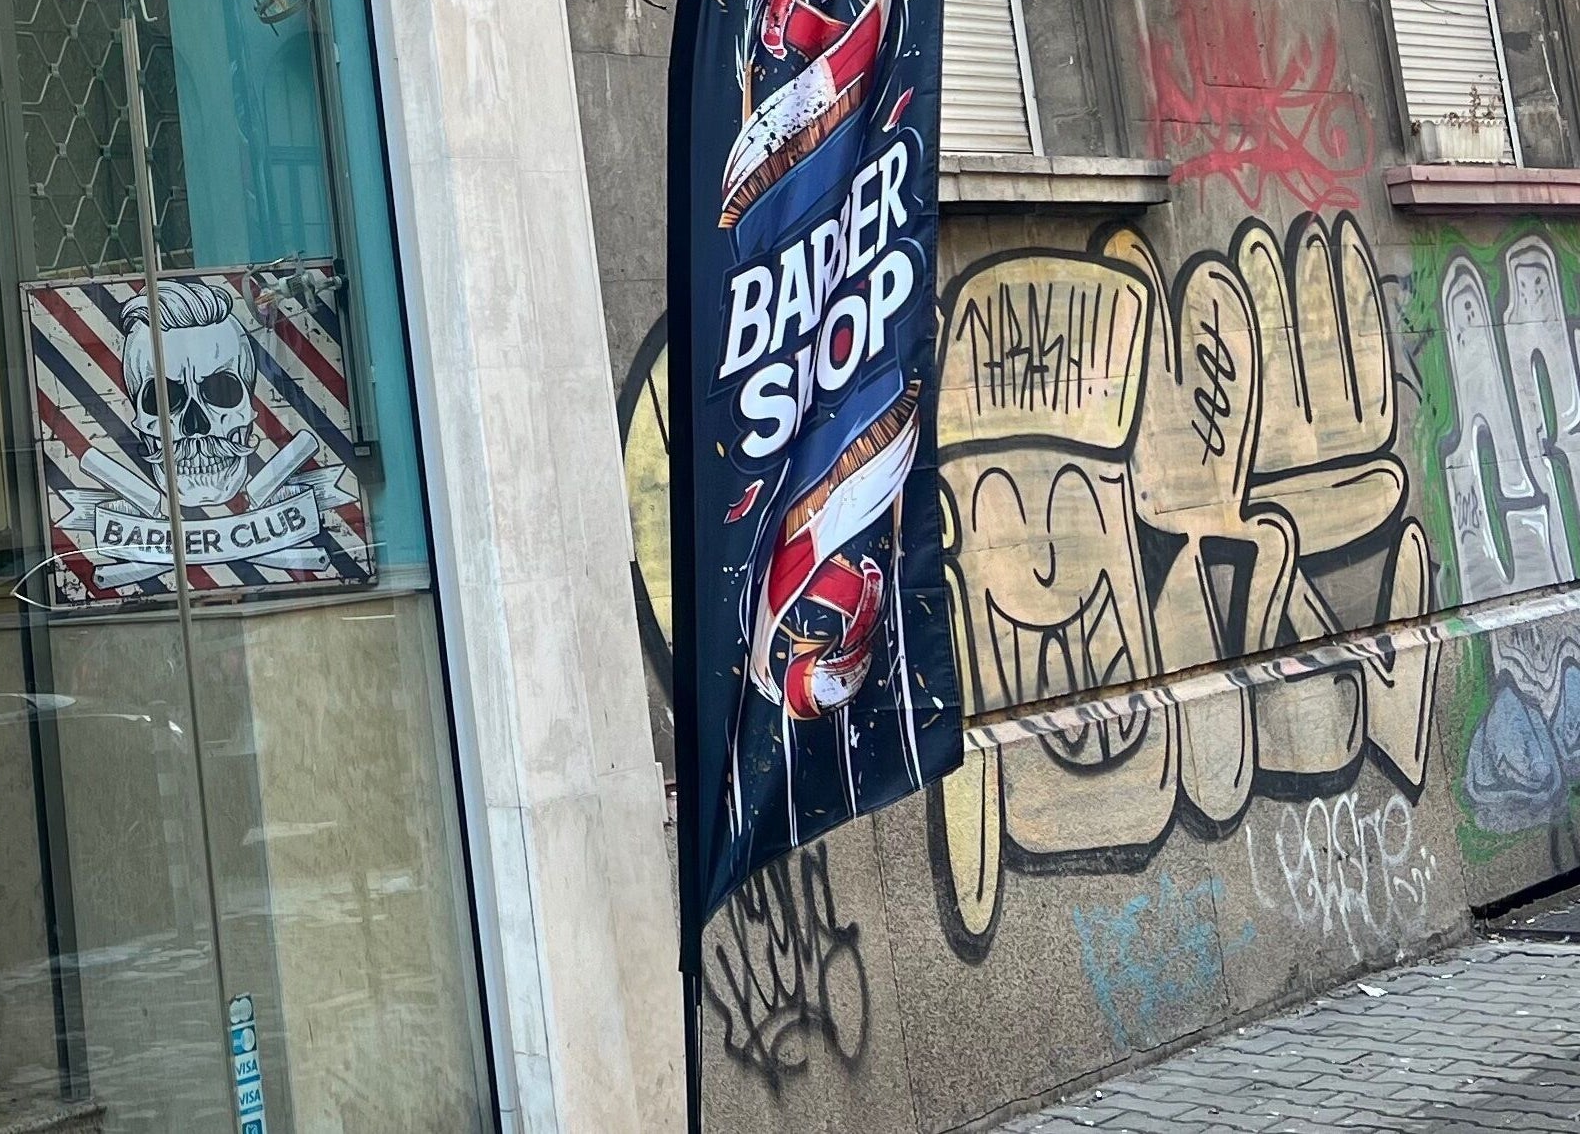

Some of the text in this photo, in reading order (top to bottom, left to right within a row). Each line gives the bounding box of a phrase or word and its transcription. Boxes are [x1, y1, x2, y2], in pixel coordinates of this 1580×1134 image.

[230, 506, 306, 548] CLUB
[236, 1059, 259, 1076] VISA
[240, 1089, 261, 1106] VISA
